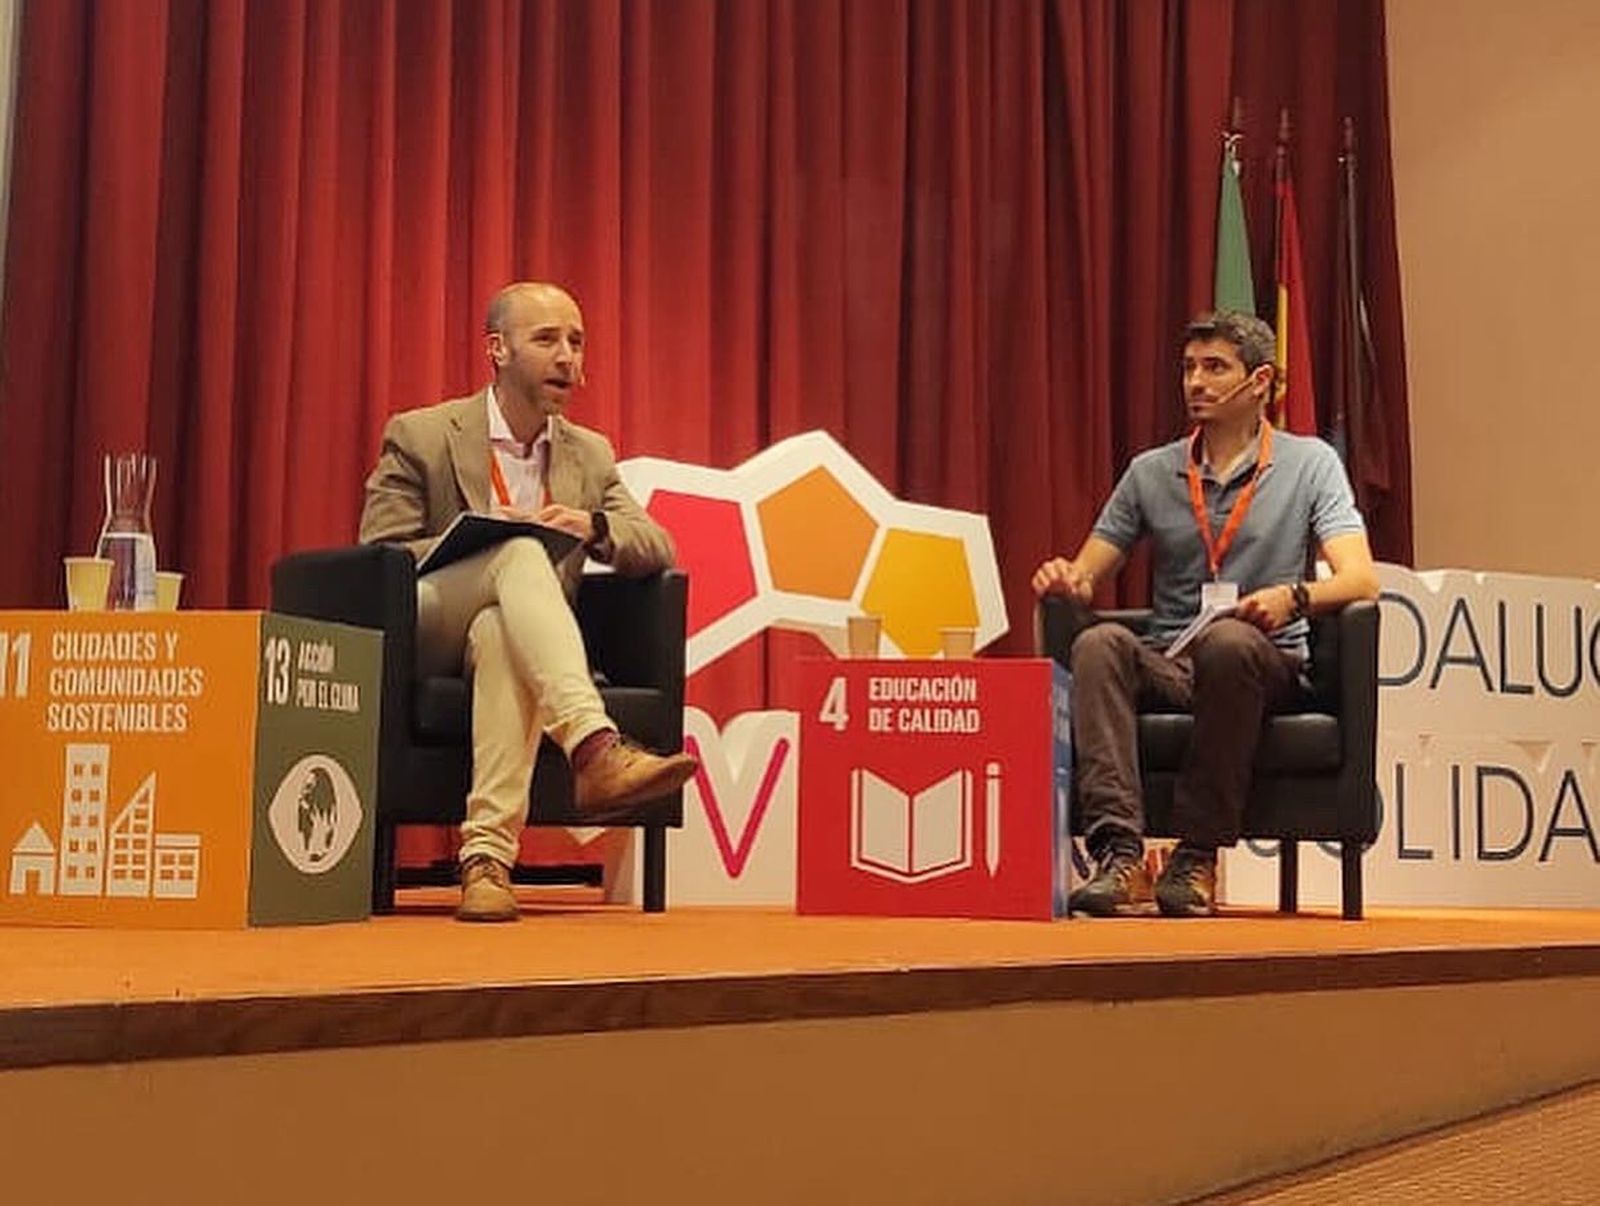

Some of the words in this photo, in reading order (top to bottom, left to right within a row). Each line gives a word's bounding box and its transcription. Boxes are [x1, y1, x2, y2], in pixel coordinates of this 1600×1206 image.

[52, 632, 157, 661] CIUDADES
[164, 632, 178, 662] Y
[1376, 592, 1600, 698] DALU
[0, 632, 31, 697] 11
[265, 637, 290, 704] 13
[50, 667, 204, 697] COMUNIDADES
[869, 674, 977, 702] EDUCACIÓN
[48, 702, 188, 733] SOSTENIBLES
[819, 676, 849, 731] 4
[868, 707, 894, 732] DE
[898, 708, 980, 734] CALIDAD
